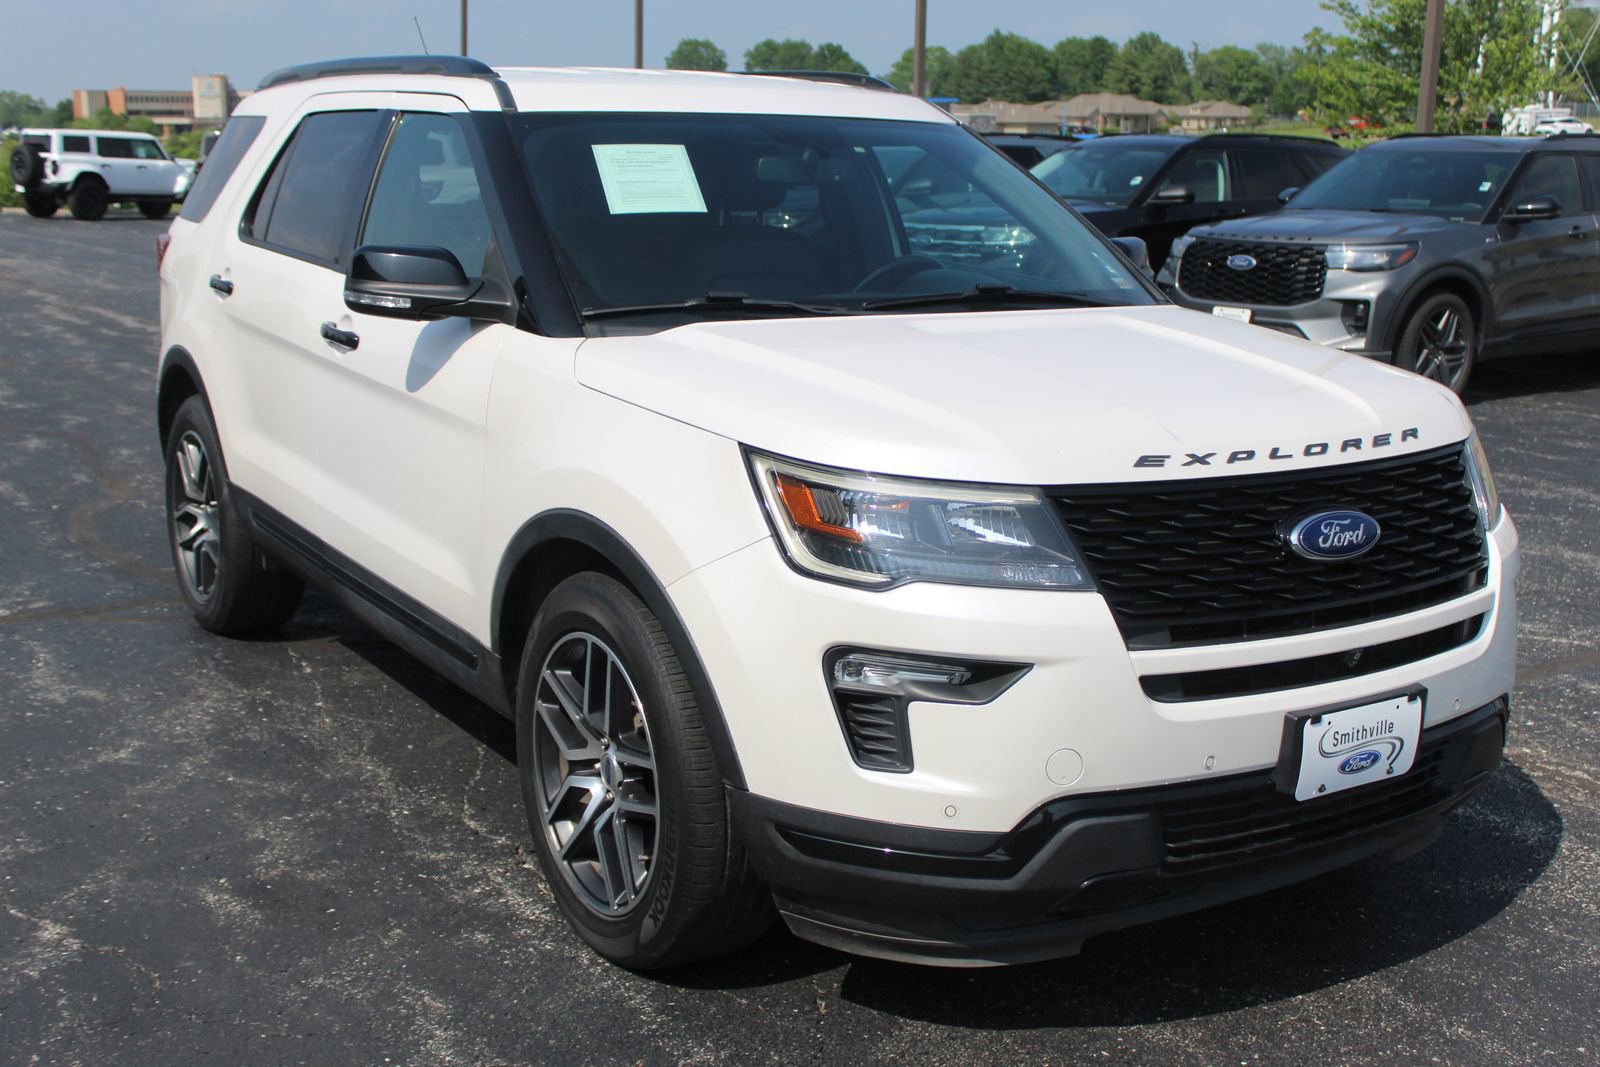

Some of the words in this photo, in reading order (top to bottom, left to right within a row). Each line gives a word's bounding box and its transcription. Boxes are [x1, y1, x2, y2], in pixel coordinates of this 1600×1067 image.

[1133, 427, 1419, 468] EXPLORER
[1318, 518, 1366, 548] Ford
[1332, 719, 1394, 747] Smithville
[1345, 753, 1374, 771] Ford
